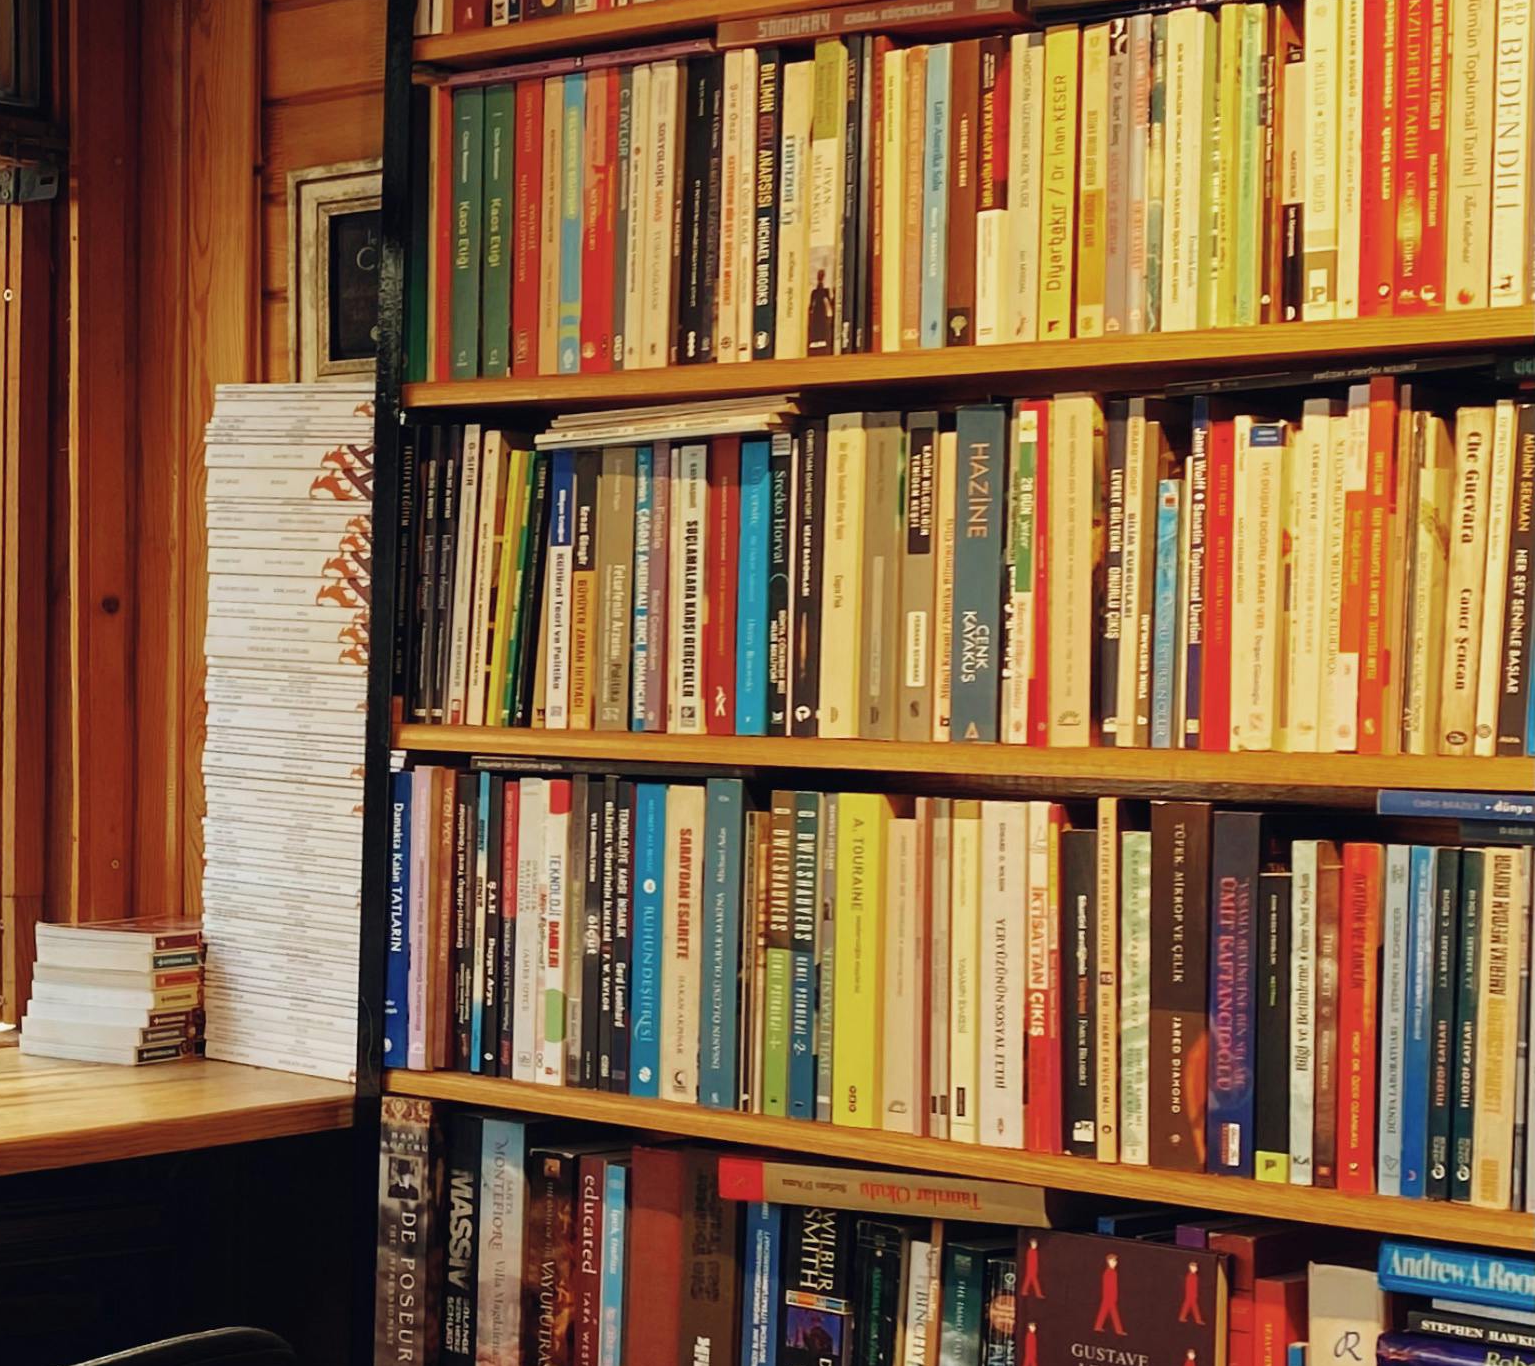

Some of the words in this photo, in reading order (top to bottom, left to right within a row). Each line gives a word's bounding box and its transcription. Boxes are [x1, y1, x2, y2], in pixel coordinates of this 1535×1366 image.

[759, 63, 776, 113] BİLİMİN
[1054, 75, 1067, 122] KESER
[1462, 51, 1480, 132] Toplumsal
[1497, 37, 1524, 140] BEDEN
[757, 149, 775, 208] ANARŞİSİ
[1463, 133, 1479, 177] Tarihi
[1495, 150, 1524, 211] DİLİ
[458, 201, 471, 235] Kaos
[489, 197, 503, 233] Kaos
[457, 238, 470, 269] Etiği
[488, 236, 502, 268] Etiği
[1046, 203, 1066, 291] Diyarbakır
[755, 264, 770, 306] BROOKS
[1194, 427, 1208, 457] Janet
[1466, 431, 1483, 465] Che
[773, 470, 788, 515] Srećko
[967, 442, 994, 539] HAZİNE
[1193, 460, 1207, 491] Wolff
[1461, 469, 1481, 544] Guevara
[1518, 481, 1534, 532] SEKMAN
[684, 520, 699, 600] SUÇLAMALARA
[773, 518, 786, 564] Horvat
[1516, 549, 1528, 572] HER
[1189, 546, 1203, 602] Toplumsal
[1511, 574, 1527, 597] ŞEY
[683, 602, 699, 635] KARŞI
[1188, 603, 1204, 644] Üretimi
[1459, 588, 1473, 633] Caner
[1509, 599, 1527, 648] SENİNLE
[681, 636, 697, 698] GERÇEKLER
[960, 610, 977, 683] KAYAKUŞ
[975, 624, 990, 669] CENK
[1455, 636, 1472, 691] Şencan
[1505, 650, 1522, 693] BAŞLAR
[392, 803, 404, 850] Damakta
[851, 818, 863, 832] A.
[392, 854, 403, 883] Kalan
[677, 828, 693, 899] SARAYDAN
[850, 837, 864, 911] TOURAINE
[390, 887, 403, 952] TATLARIN
[1173, 871, 1186, 922] MİKROP
[676, 903, 690, 960] ESARETE
[1031, 885, 1048, 984] İKTİSATTAN
[1173, 924, 1185, 942] VE
[994, 918, 1009, 1004] YERYÜZÜNÜN
[1170, 944, 1186, 983] ÇELİK
[994, 1004, 1006, 1050] SOSYAL
[1027, 991, 1046, 1036] ÇIKIŞ
[1171, 1017, 1182, 1054] JARED
[994, 1053, 1007, 1090] FETHİ
[1171, 1059, 1182, 1114] DIAMOND
[488, 1141, 510, 1251] MONTEFIORE
[400, 1211, 417, 1243] DE
[447, 1169, 474, 1291] MASSIV
[580, 1175, 599, 1275] educated
[799, 1206, 820, 1289] SMITH
[816, 1209, 838, 1291] WILBUR
[1388, 1248, 1465, 1284] Andrew
[397, 1256, 416, 1363] POSEUR
[581, 1291, 592, 1325] TARA
[1421, 1319, 1484, 1339] STEPHEN
